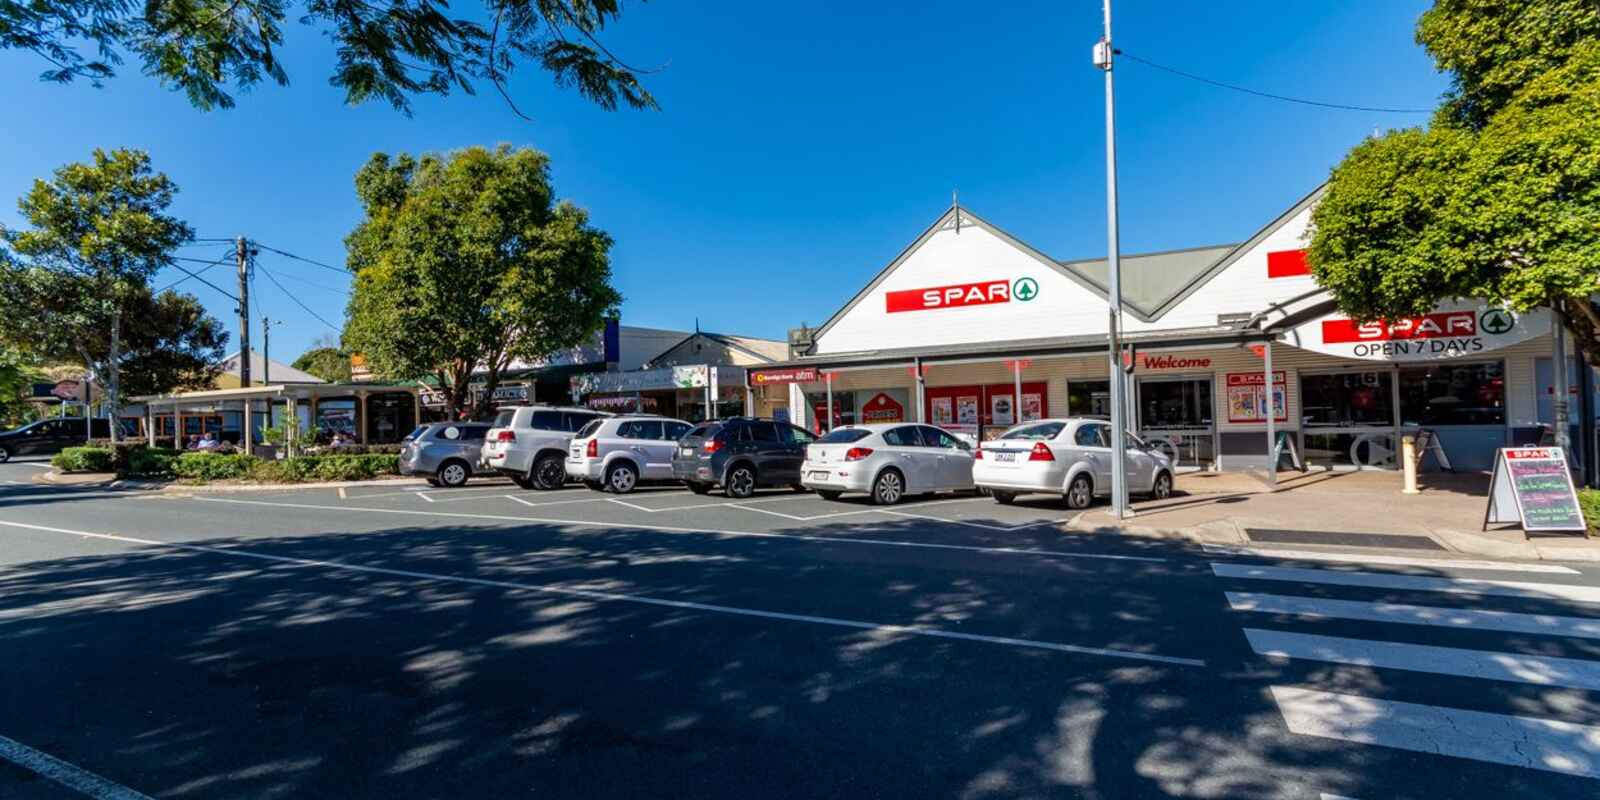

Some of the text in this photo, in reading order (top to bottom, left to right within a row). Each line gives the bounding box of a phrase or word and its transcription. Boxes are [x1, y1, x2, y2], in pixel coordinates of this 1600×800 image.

[922, 284, 1008, 306] SPAR
[1353, 338, 1484, 357] OPEN 7 DAYS
[1143, 354, 1212, 369] Welcome
[795, 370, 814, 381] atm
[1513, 450, 1552, 459] SPAR
